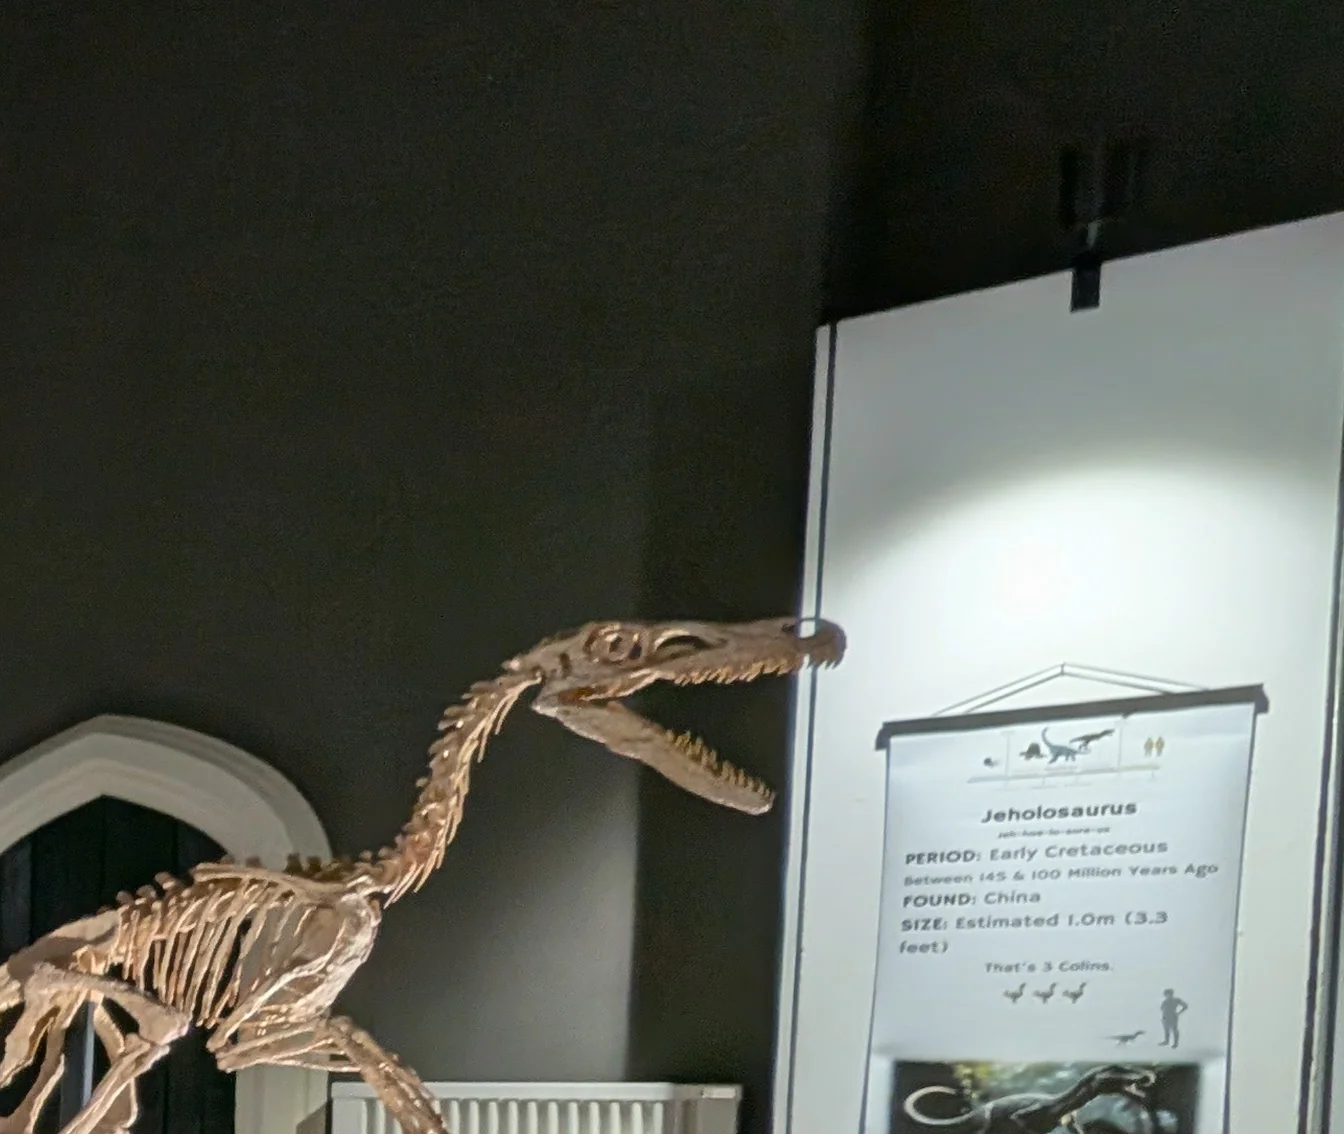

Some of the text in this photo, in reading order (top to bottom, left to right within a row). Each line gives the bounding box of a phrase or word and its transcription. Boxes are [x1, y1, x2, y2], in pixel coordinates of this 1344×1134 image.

[981, 802, 1137, 824] Jeholosaurus
[905, 842, 1169, 865] PERIOD: Early Cretaceous
[903, 863, 1219, 887] Between 145 & 100 Million Years Ago
[903, 889, 1042, 909] FOUND: China
[900, 910, 1169, 932] SIZE: Estimated 1.0m (3.3
[899, 939, 949, 955] feet)
[985, 960, 1114, 974] That's 3 Colins.
